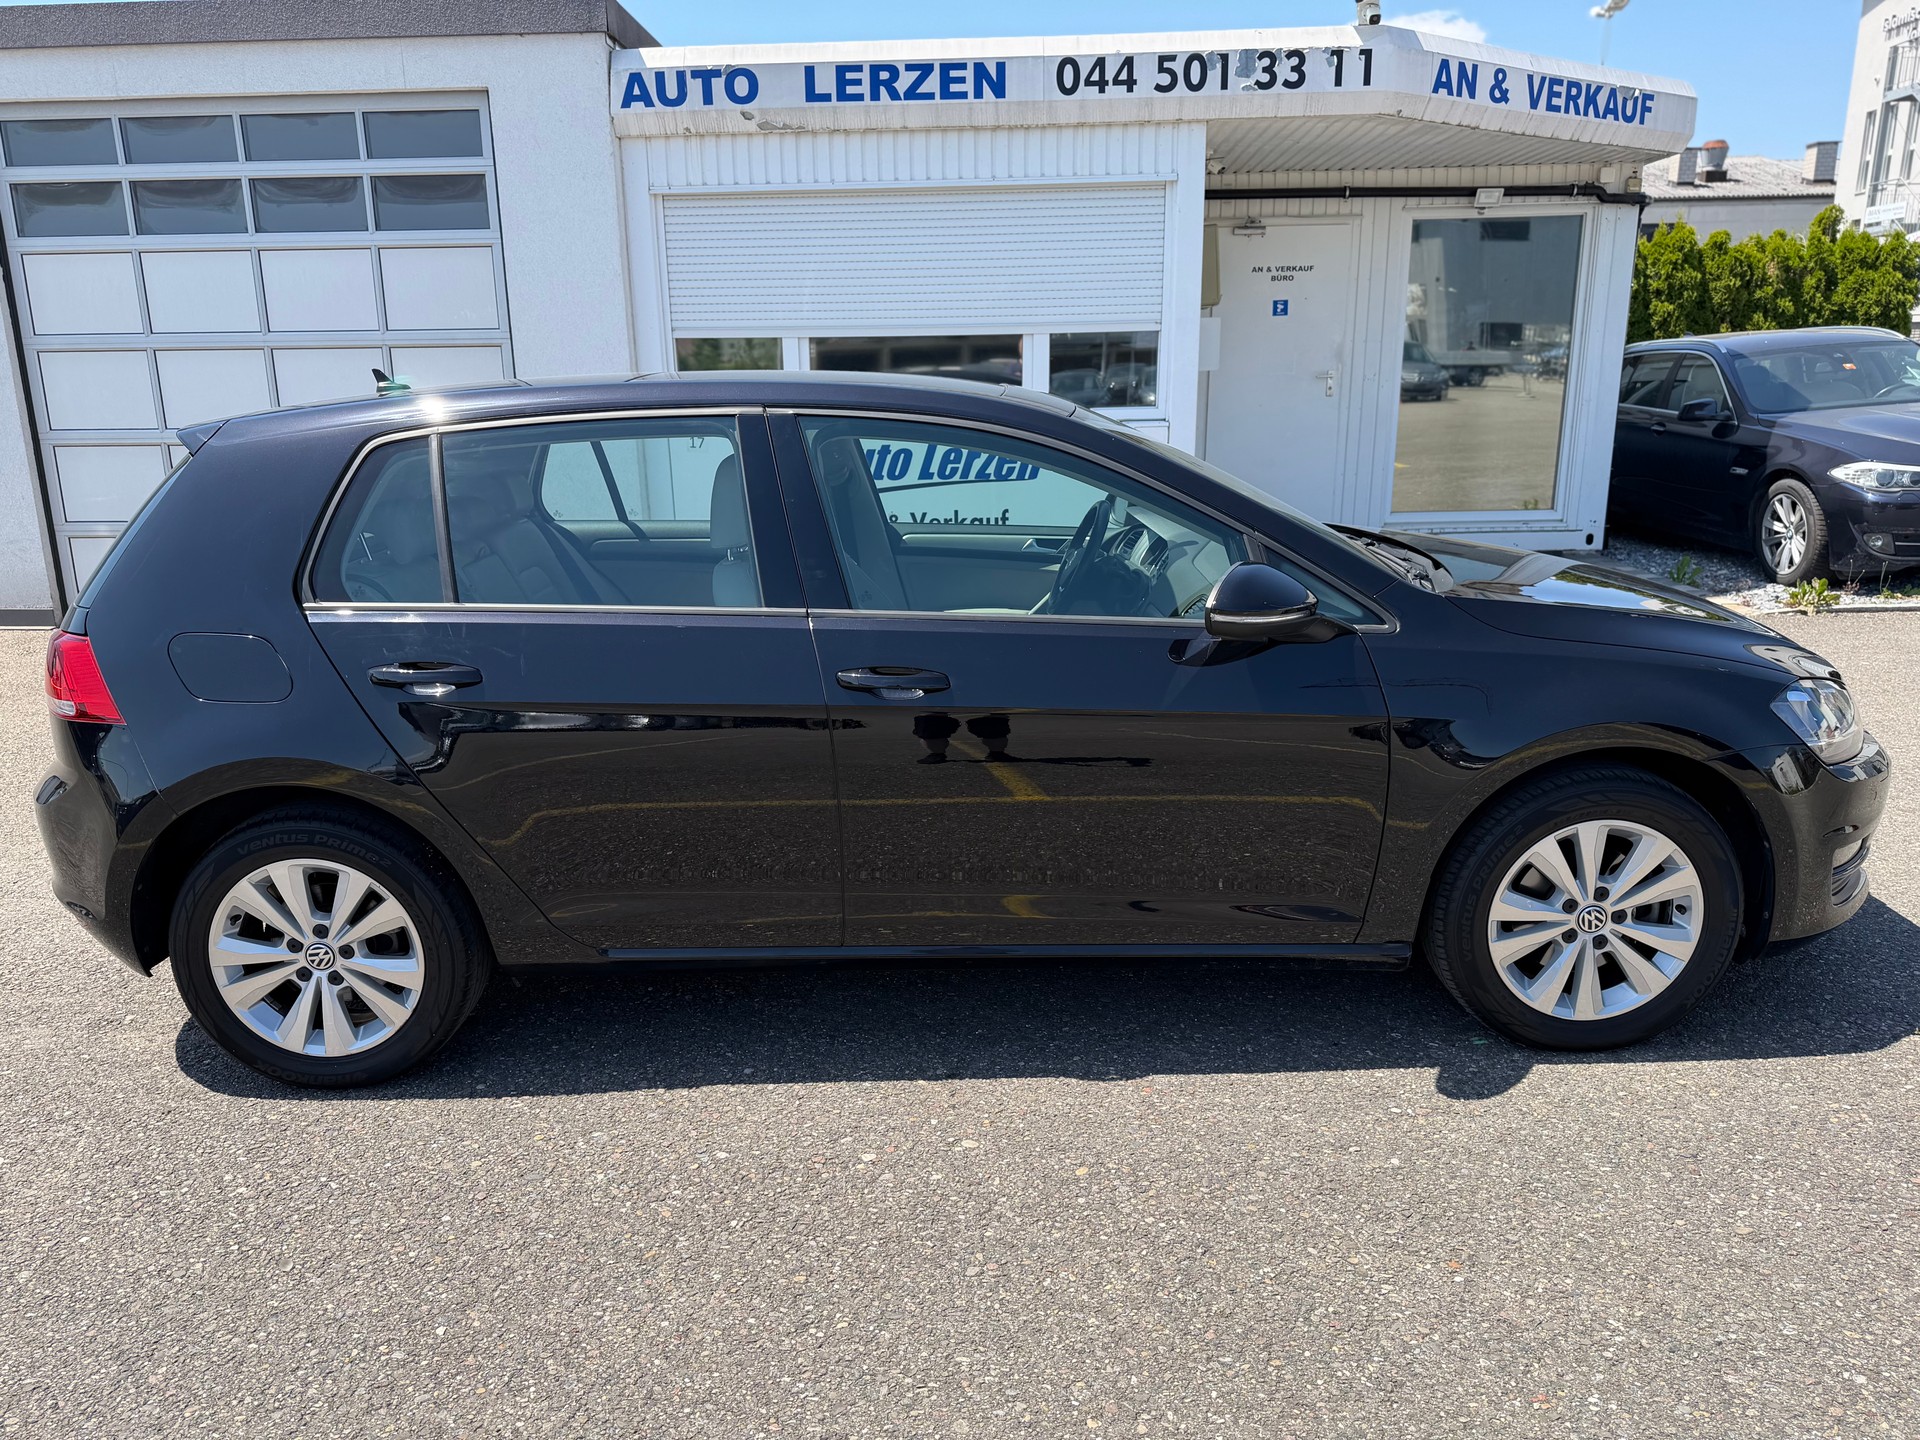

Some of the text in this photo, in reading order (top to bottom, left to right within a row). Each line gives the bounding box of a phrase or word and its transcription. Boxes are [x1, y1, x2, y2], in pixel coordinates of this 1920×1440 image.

[620, 61, 1007, 109] AUTO LERZEN
[1056, 55, 1138, 97] 044
[1153, 52, 1230, 93] 501
[1254, 49, 1307, 91] 33
[1431, 58, 1655, 126] AN & VERKAUF
[1266, 265, 1272, 273] &
[1275, 265, 1315, 273] VERKAUF
[1270, 273, 1295, 282] BÜRO
[689, 436, 705, 449] 17
